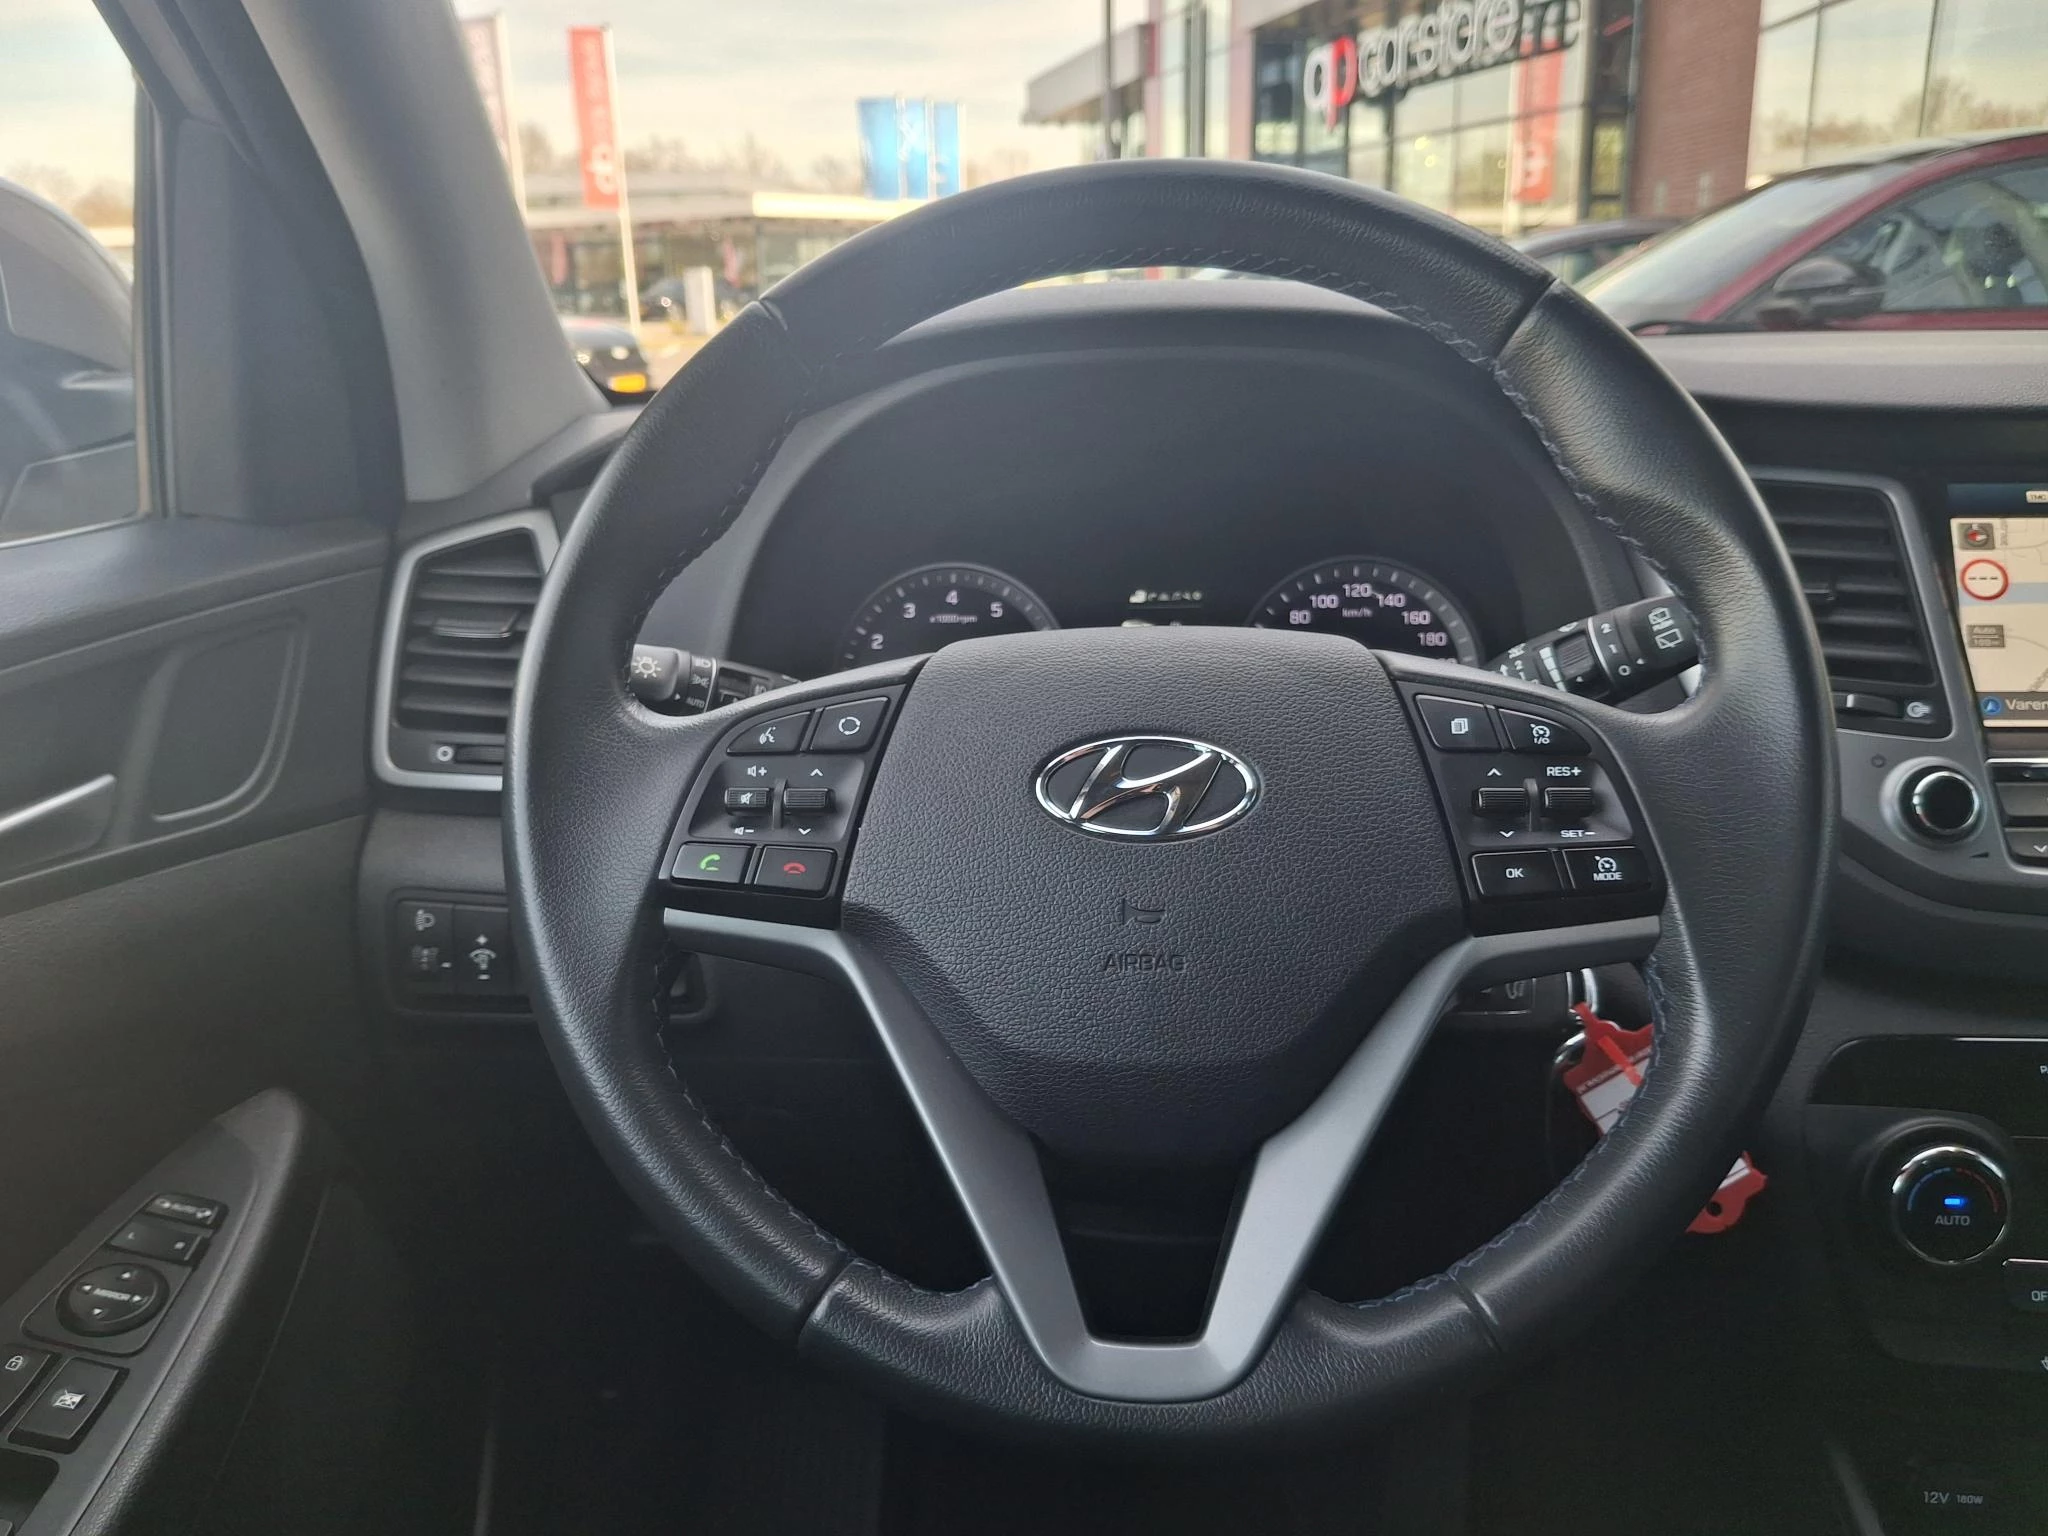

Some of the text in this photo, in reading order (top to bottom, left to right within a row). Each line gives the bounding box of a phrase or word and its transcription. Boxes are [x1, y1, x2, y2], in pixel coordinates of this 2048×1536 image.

[945, 590, 958, 605] 4
[1342, 583, 1372, 598] 120
[1309, 594, 1339, 609] 100
[1377, 593, 1406, 608] 140
[903, 603, 916, 619] 3
[990, 602, 1003, 618] 5
[1289, 610, 1311, 625] 80
[1342, 608, 1373, 618] km/h
[1402, 610, 1431, 625] 160
[871, 634, 884, 650] 2
[1418, 632, 1448, 647] 180
[1506, 868, 1523, 878] OK
[1593, 872, 1622, 881] MODE
[1102, 954, 1186, 973] AIRBAG
[1934, 1215, 1970, 1226] AUTO
[1923, 1491, 1950, 1504] 12V
